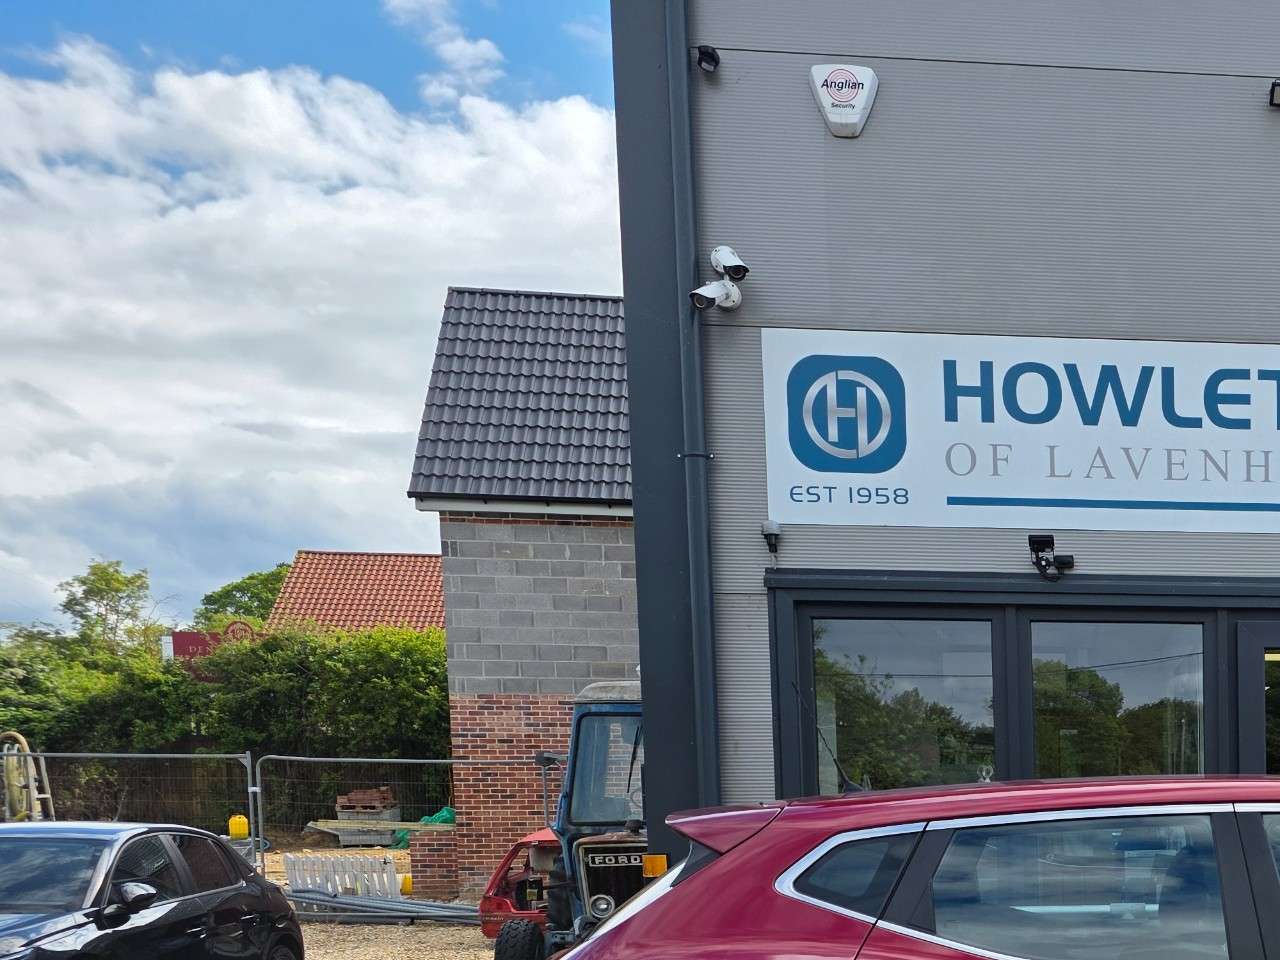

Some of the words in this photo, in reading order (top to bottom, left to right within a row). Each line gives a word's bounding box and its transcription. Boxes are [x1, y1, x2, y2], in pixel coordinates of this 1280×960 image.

[821, 79, 864, 91] Anglian
[945, 443, 1012, 477] OF
[790, 486, 837, 503] EST
[849, 487, 908, 504] 1958
[595, 855, 640, 864] FORD
